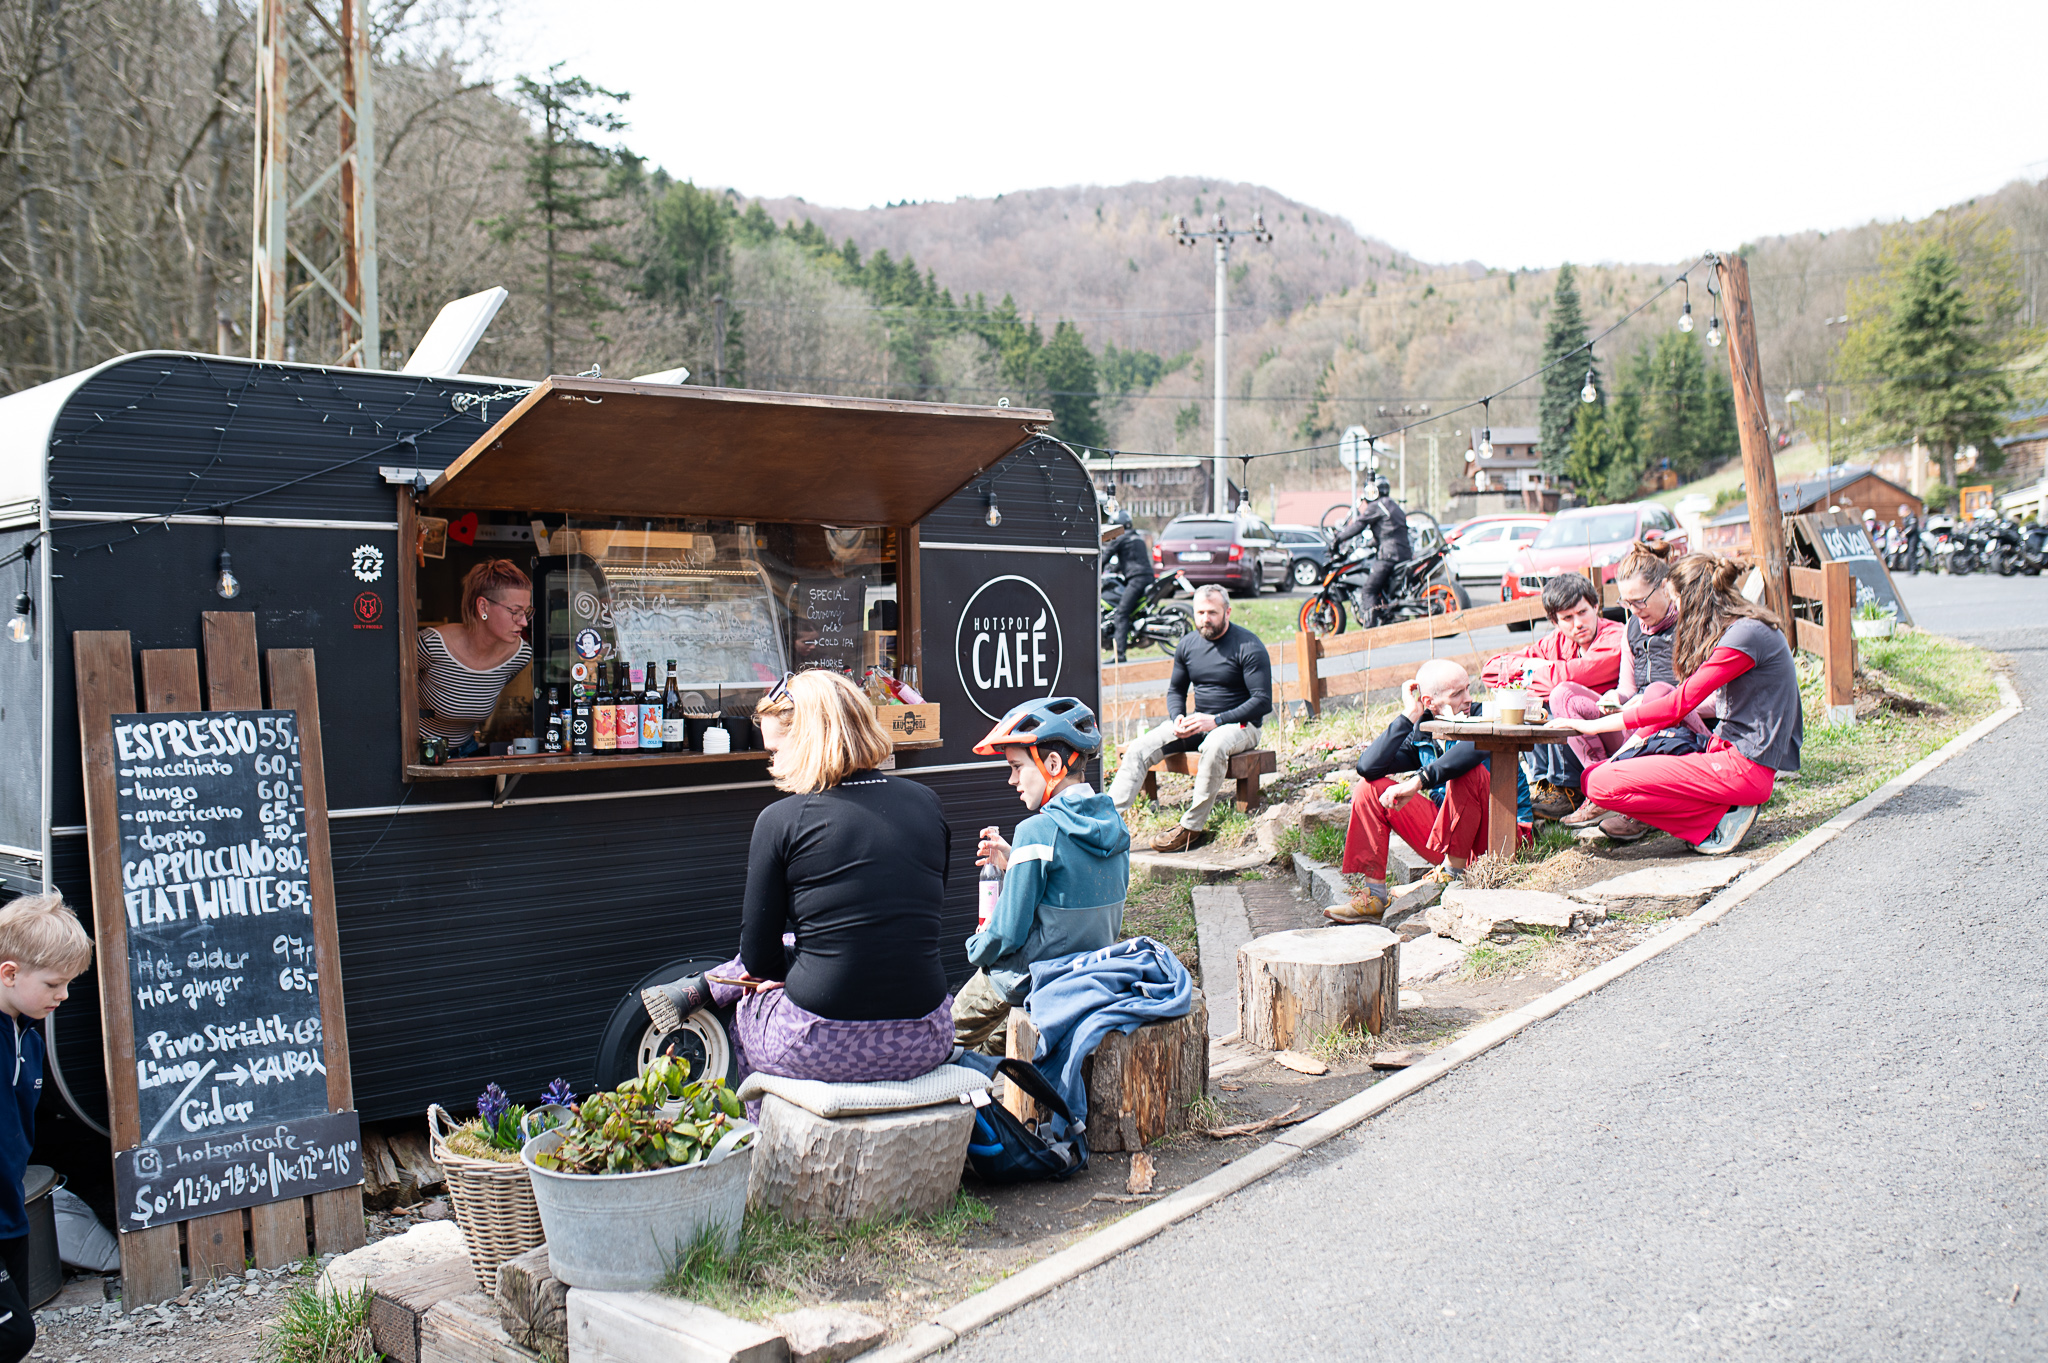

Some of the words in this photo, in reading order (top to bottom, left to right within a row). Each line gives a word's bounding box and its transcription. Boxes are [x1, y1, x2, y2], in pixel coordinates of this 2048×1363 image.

[351, 559, 384, 571] ZFZ
[809, 586, 849, 601] SPECIÁL
[974, 616, 1030, 631] HOTSPOT
[818, 637, 839, 647] COLD
[842, 637, 854, 648] IPA
[972, 607, 1049, 690] CAFÉ
[820, 652, 844, 668] HORKÉ
[115, 717, 258, 761] ESPRESSO
[123, 838, 275, 890] CAPPUCCINO
[124, 882, 191, 927] FLAT
[191, 876, 279, 920] WHITE
[181, 976, 244, 1011] ginger
[147, 1030, 204, 1059] Pivo
[180, 1086, 254, 1132] Cider
